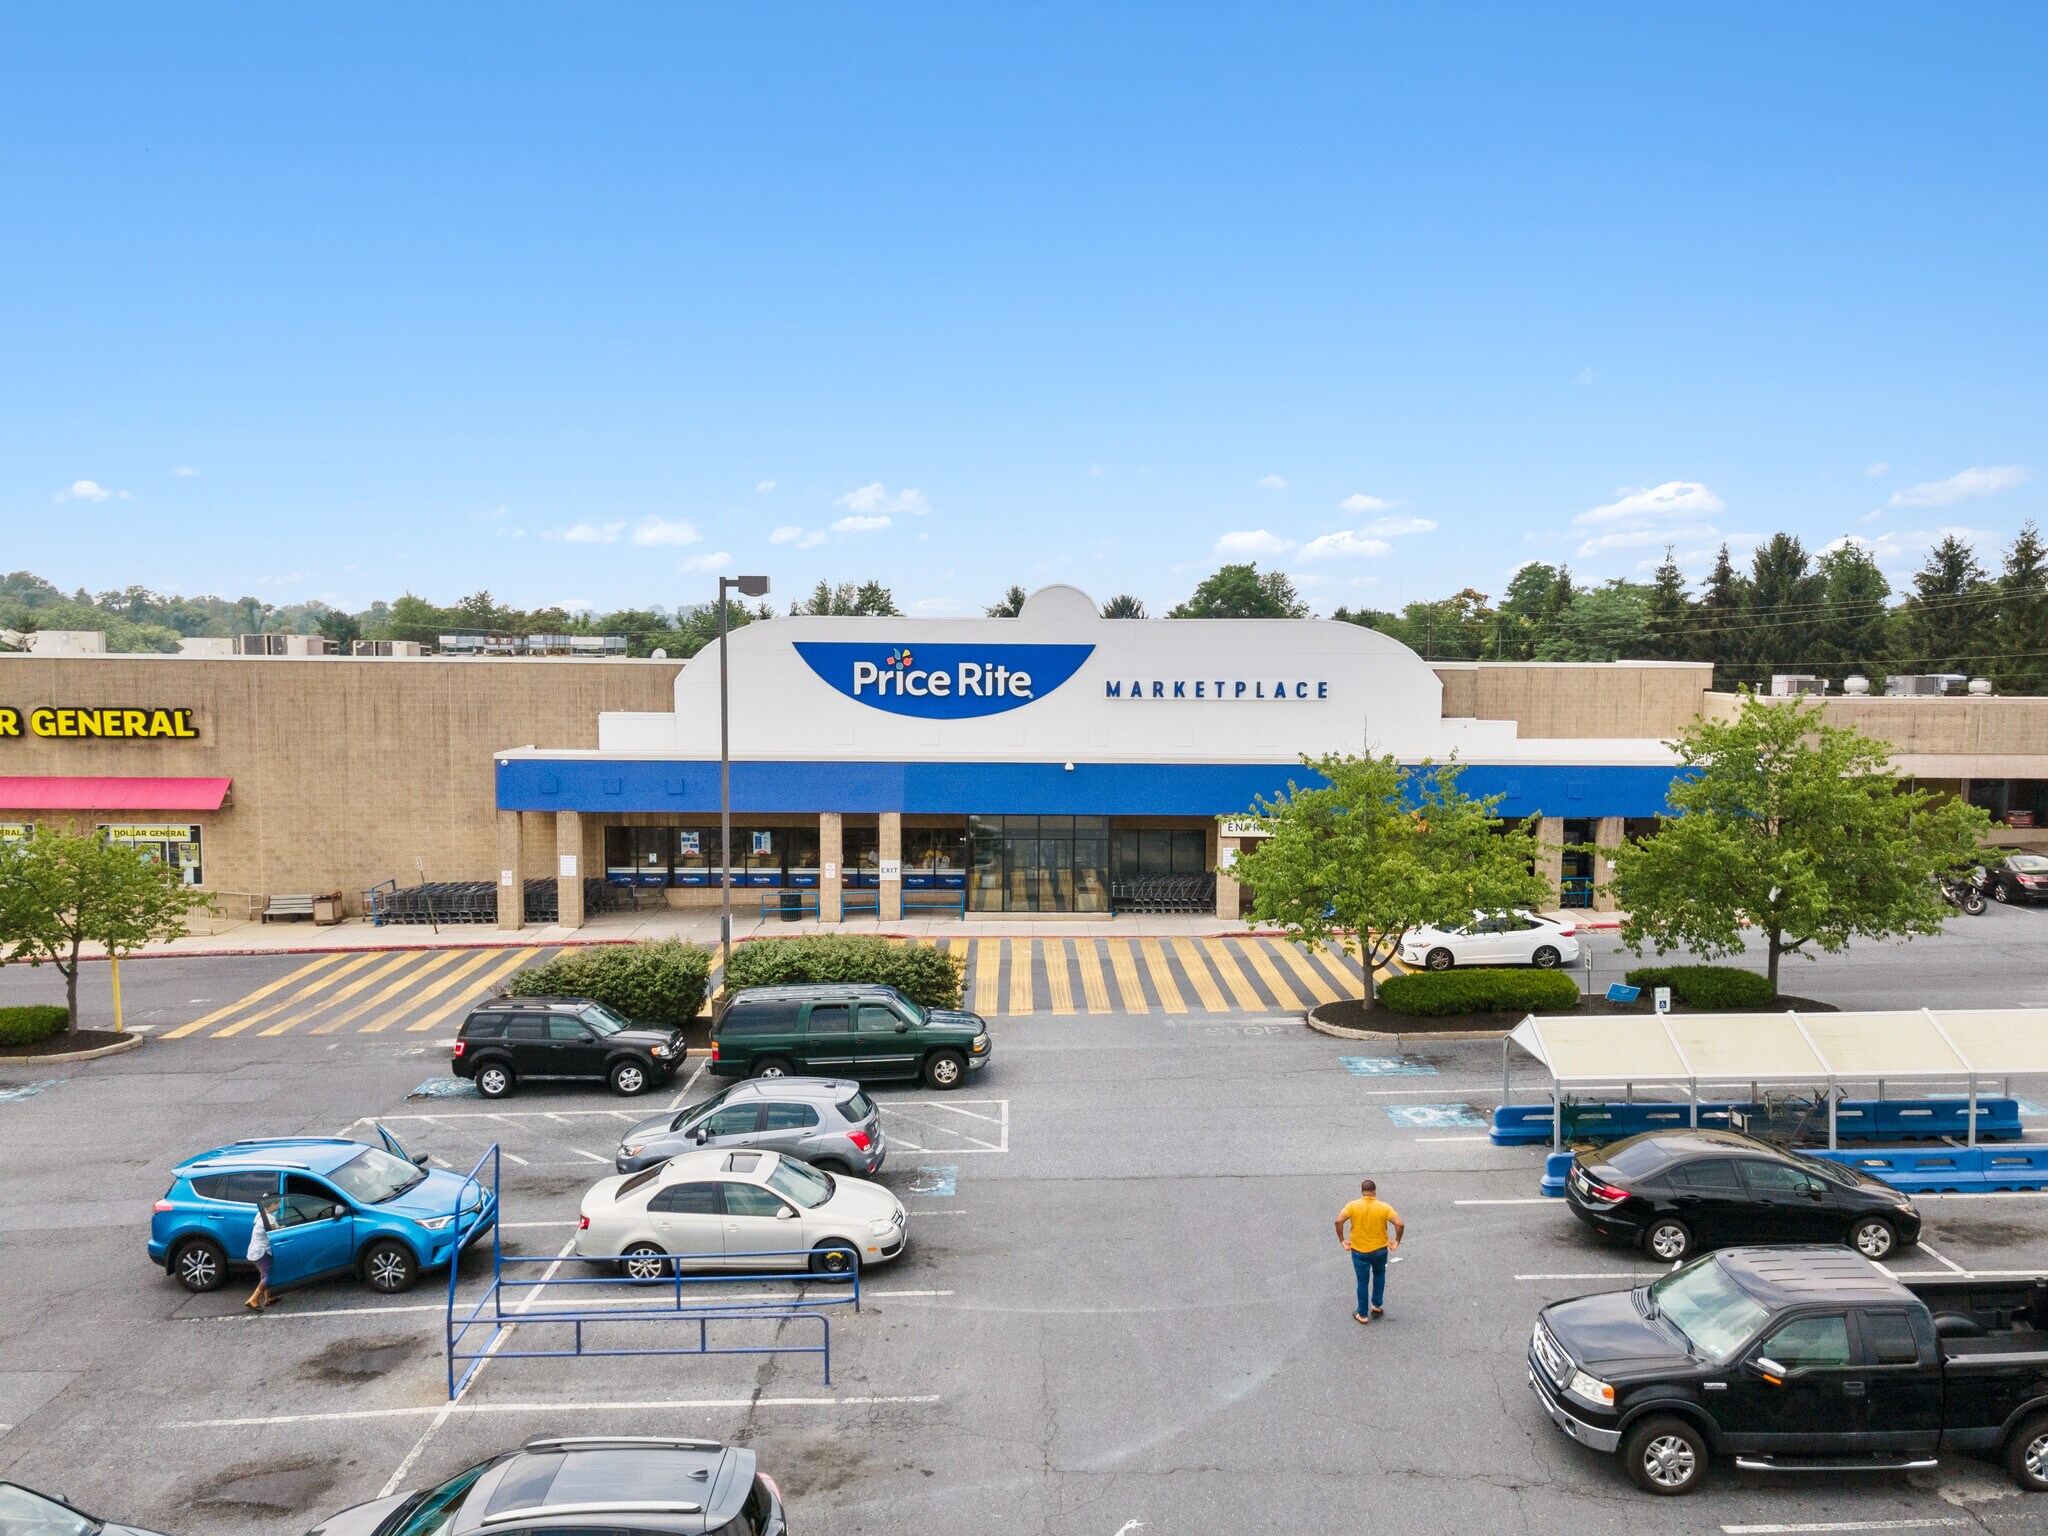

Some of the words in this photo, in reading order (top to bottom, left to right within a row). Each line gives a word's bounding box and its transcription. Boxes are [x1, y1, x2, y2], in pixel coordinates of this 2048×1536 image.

[853, 661, 951, 696] Price
[958, 662, 1033, 697] Rite
[1105, 680, 1328, 699] MARKETPLACE
[31, 709, 195, 737] GENERAL
[114, 829, 147, 838] DOLLAR
[149, 829, 187, 837] GENERAL
